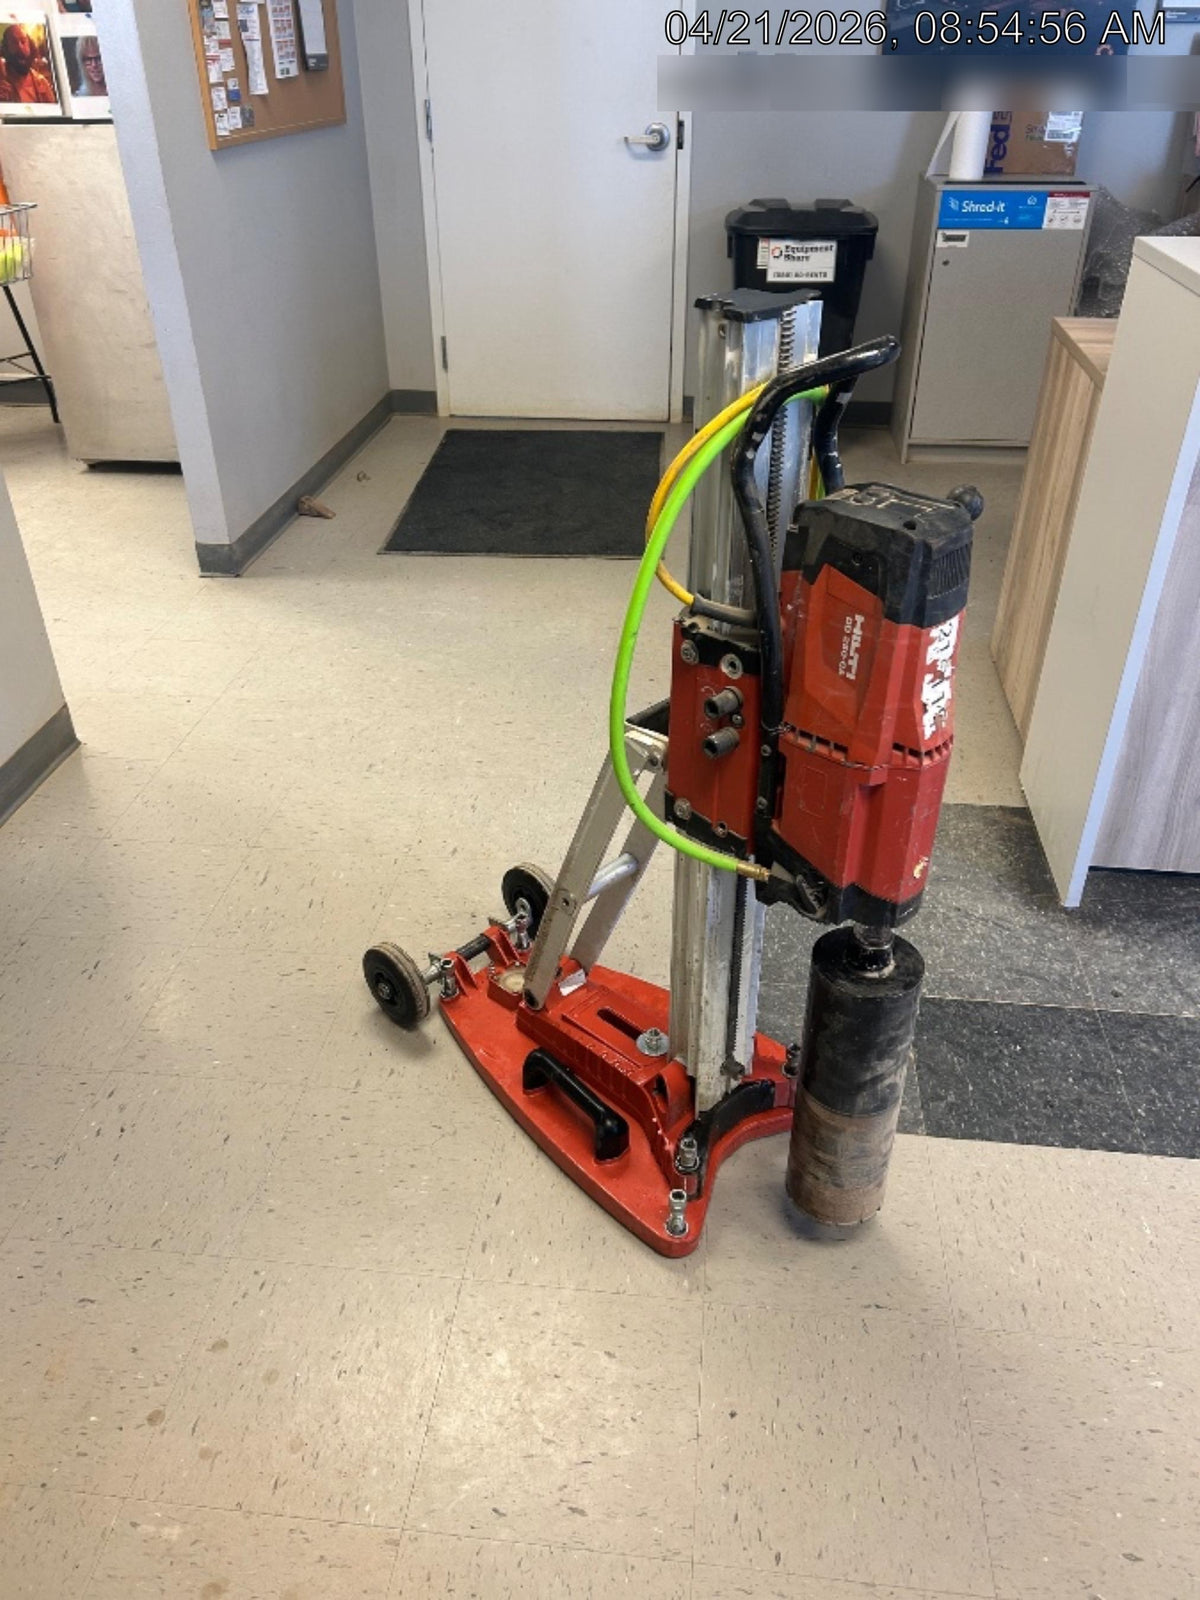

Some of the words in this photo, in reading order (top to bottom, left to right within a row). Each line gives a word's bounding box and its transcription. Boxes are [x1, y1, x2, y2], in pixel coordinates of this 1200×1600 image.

[961, 200, 1006, 213] Shred-it
[784, 245, 834, 254] Equipment
[784, 254, 810, 262] Share
[845, 614, 865, 680] HILTI
